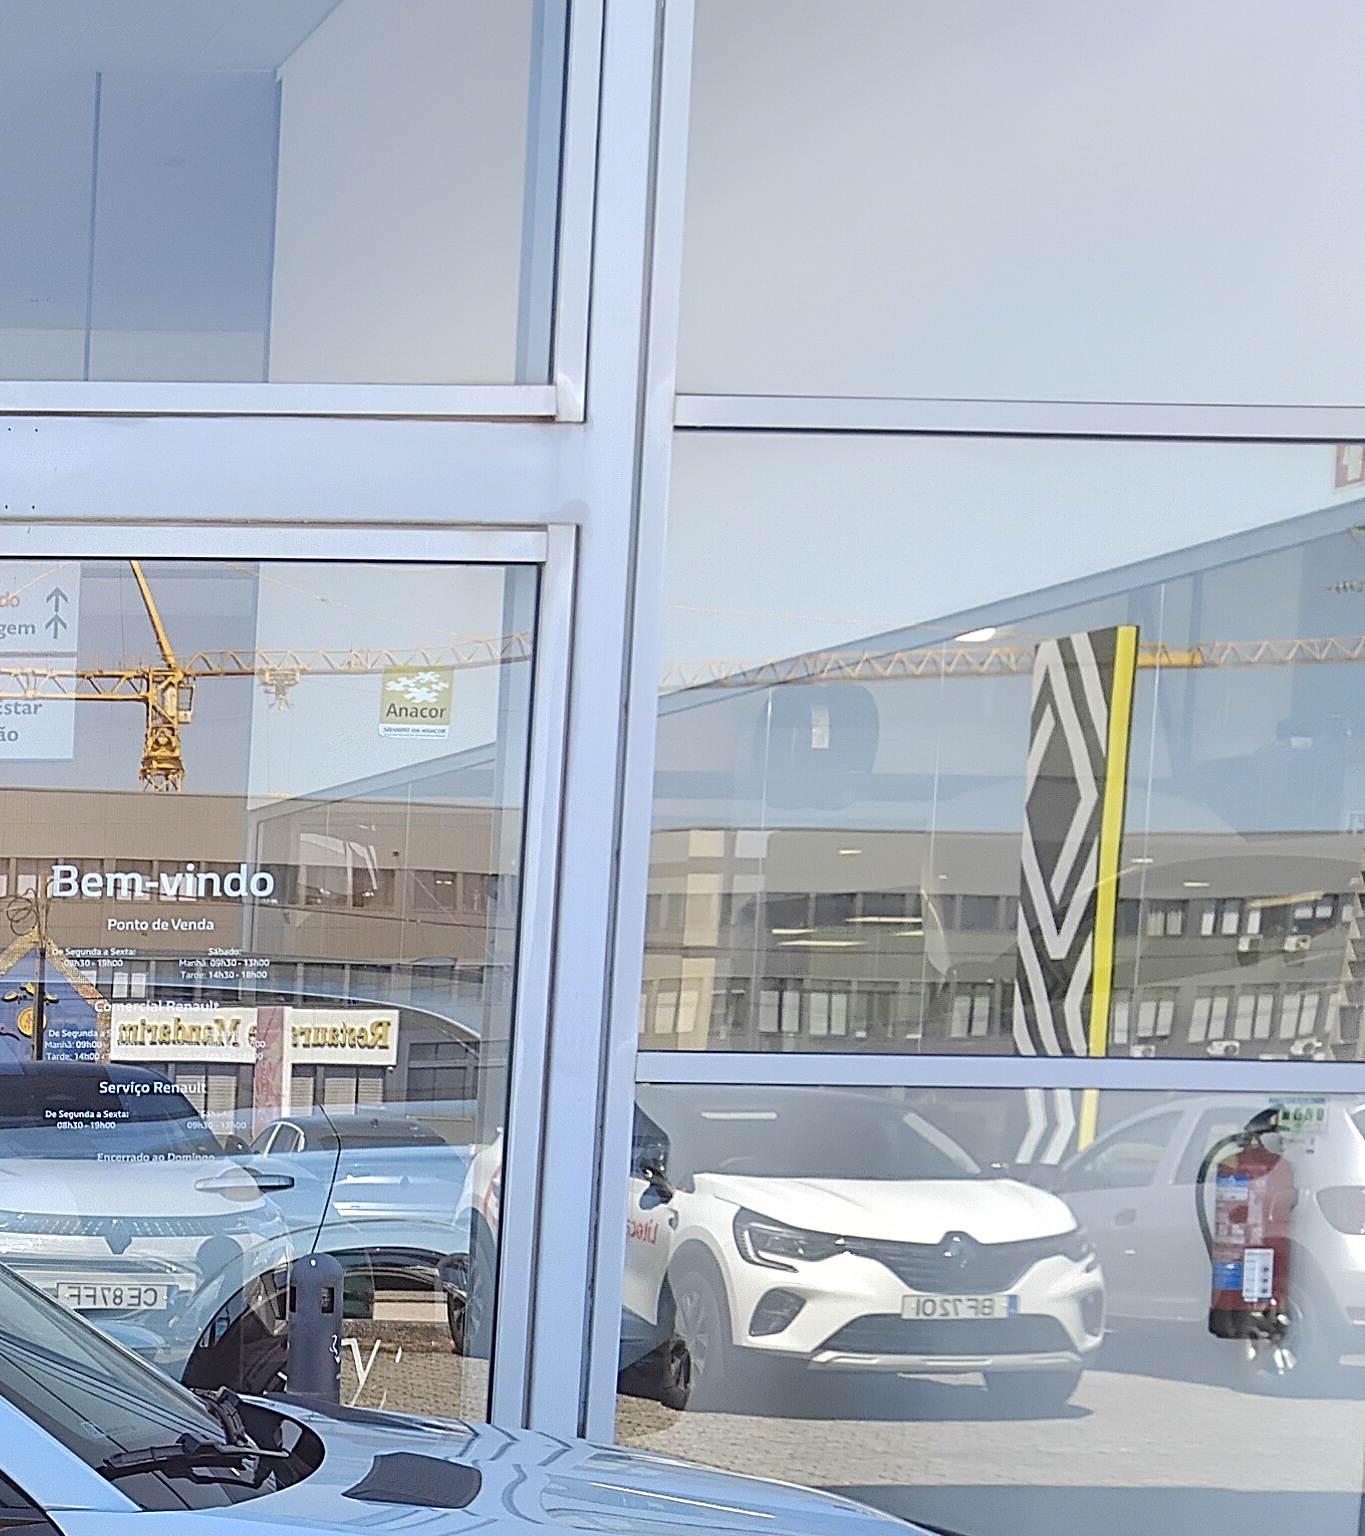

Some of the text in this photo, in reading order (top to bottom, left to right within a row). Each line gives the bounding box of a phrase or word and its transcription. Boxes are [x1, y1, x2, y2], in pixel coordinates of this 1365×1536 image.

[386, 702, 447, 718] Anacor
[51, 863, 274, 897] Bem-vindo
[107, 918, 214, 931] Ponto de Venda
[65, 948, 101, 958] Segunda
[94, 1000, 164, 1012] Comercial
[99, 1081, 207, 1096] Serviço Renault
[45, 1110, 57, 1118] De
[59, 1110, 94, 1120] Segunda
[103, 1110, 129, 1118] Sexta:
[90, 1121, 116, 1130] 19h00
